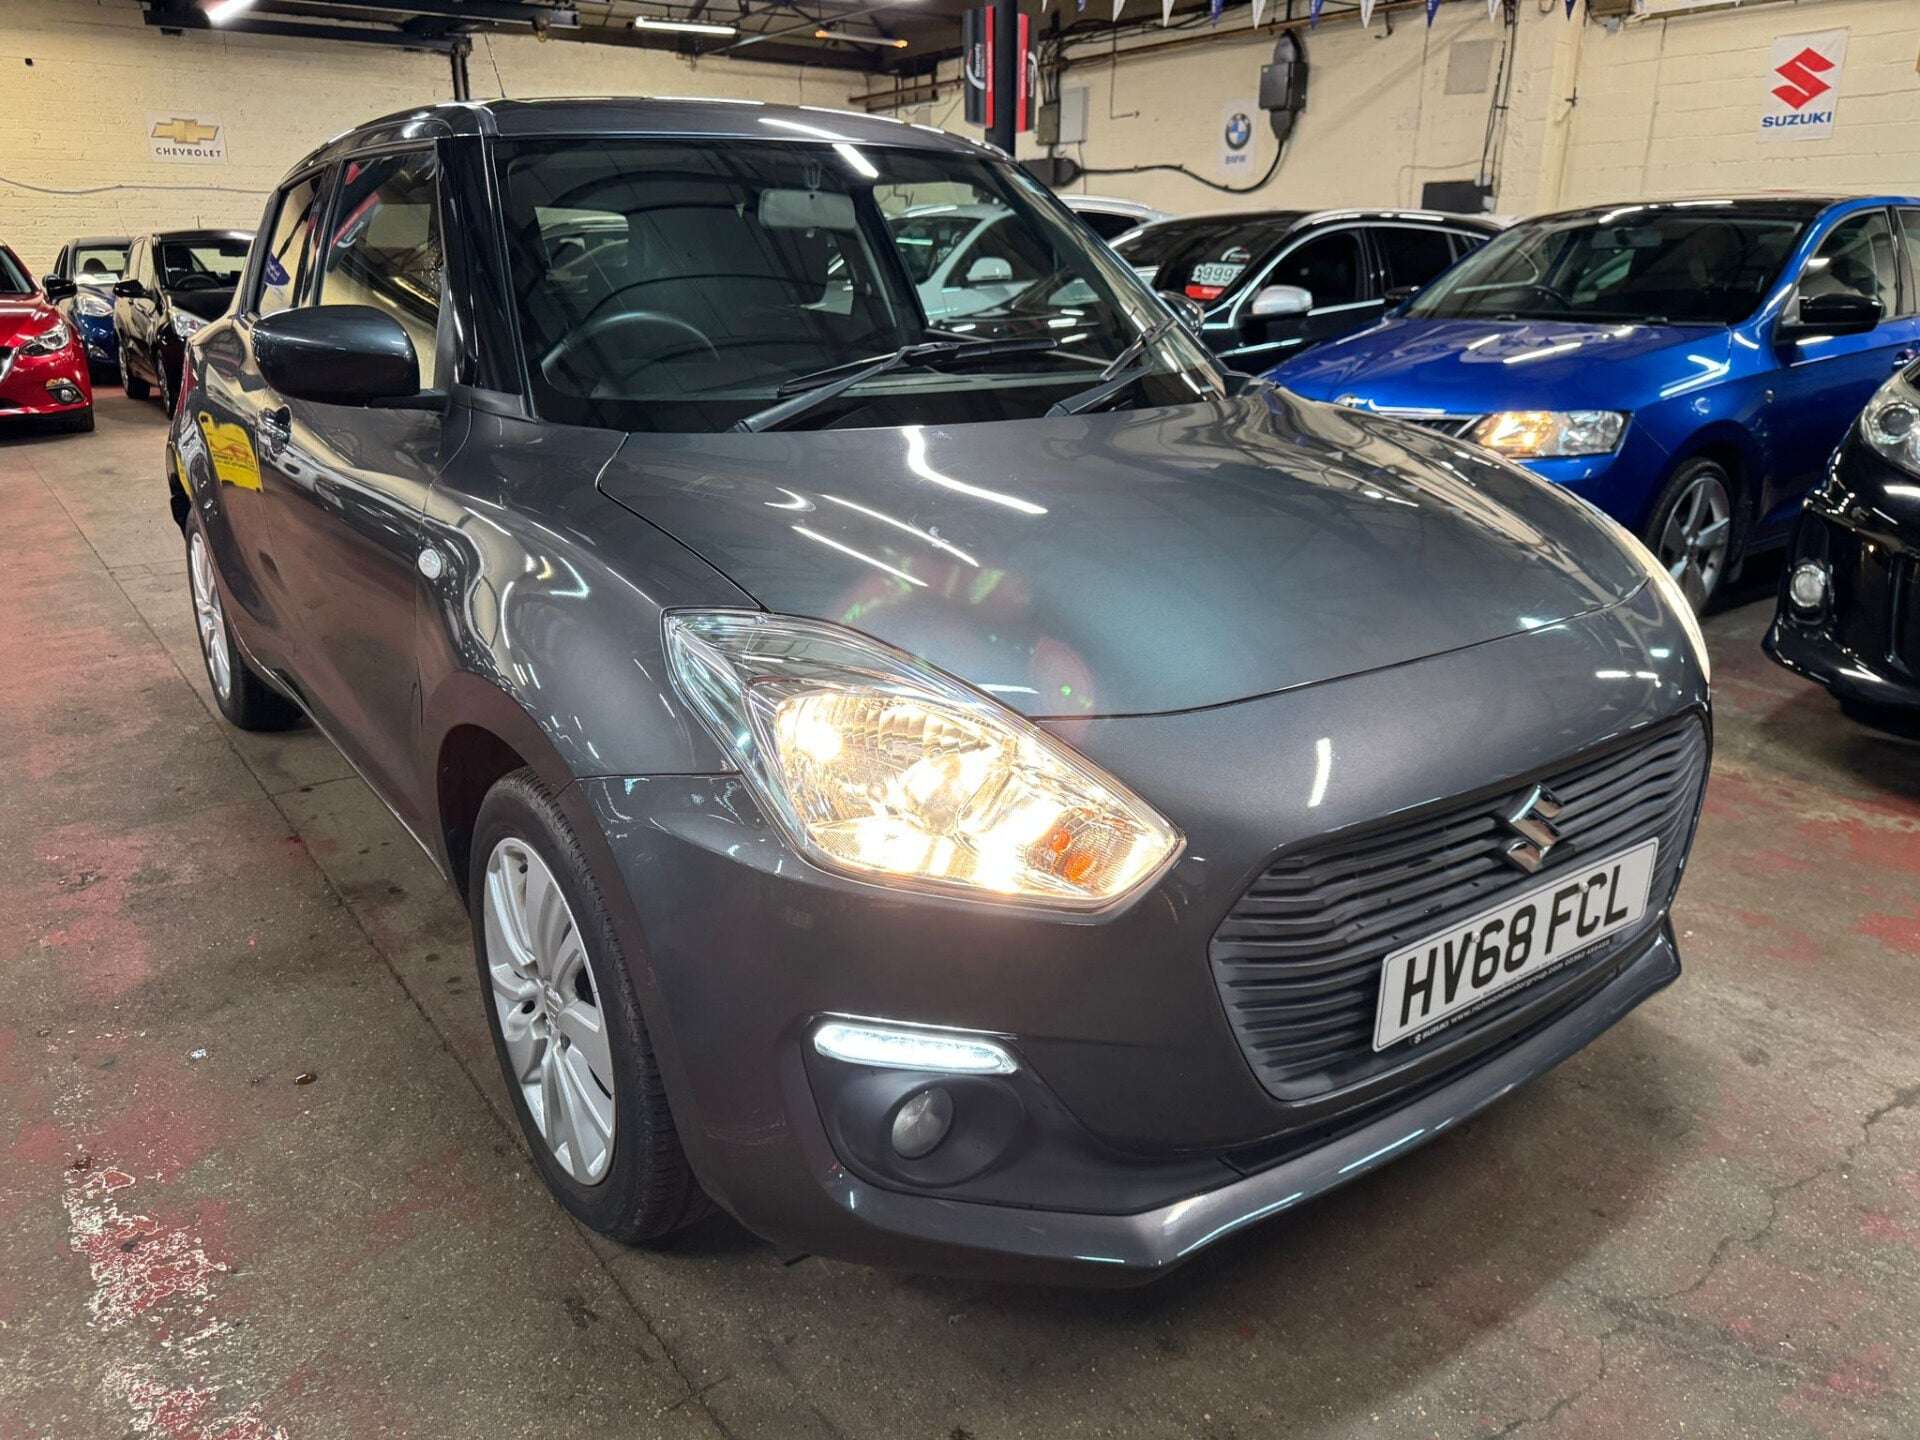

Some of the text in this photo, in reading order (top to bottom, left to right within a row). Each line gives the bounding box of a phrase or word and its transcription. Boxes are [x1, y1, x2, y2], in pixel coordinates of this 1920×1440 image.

[1761, 111, 1833, 128] SUZUKI
[155, 147, 222, 158] CHEVROLET
[1400, 865, 1629, 1028] HV68 FCL
